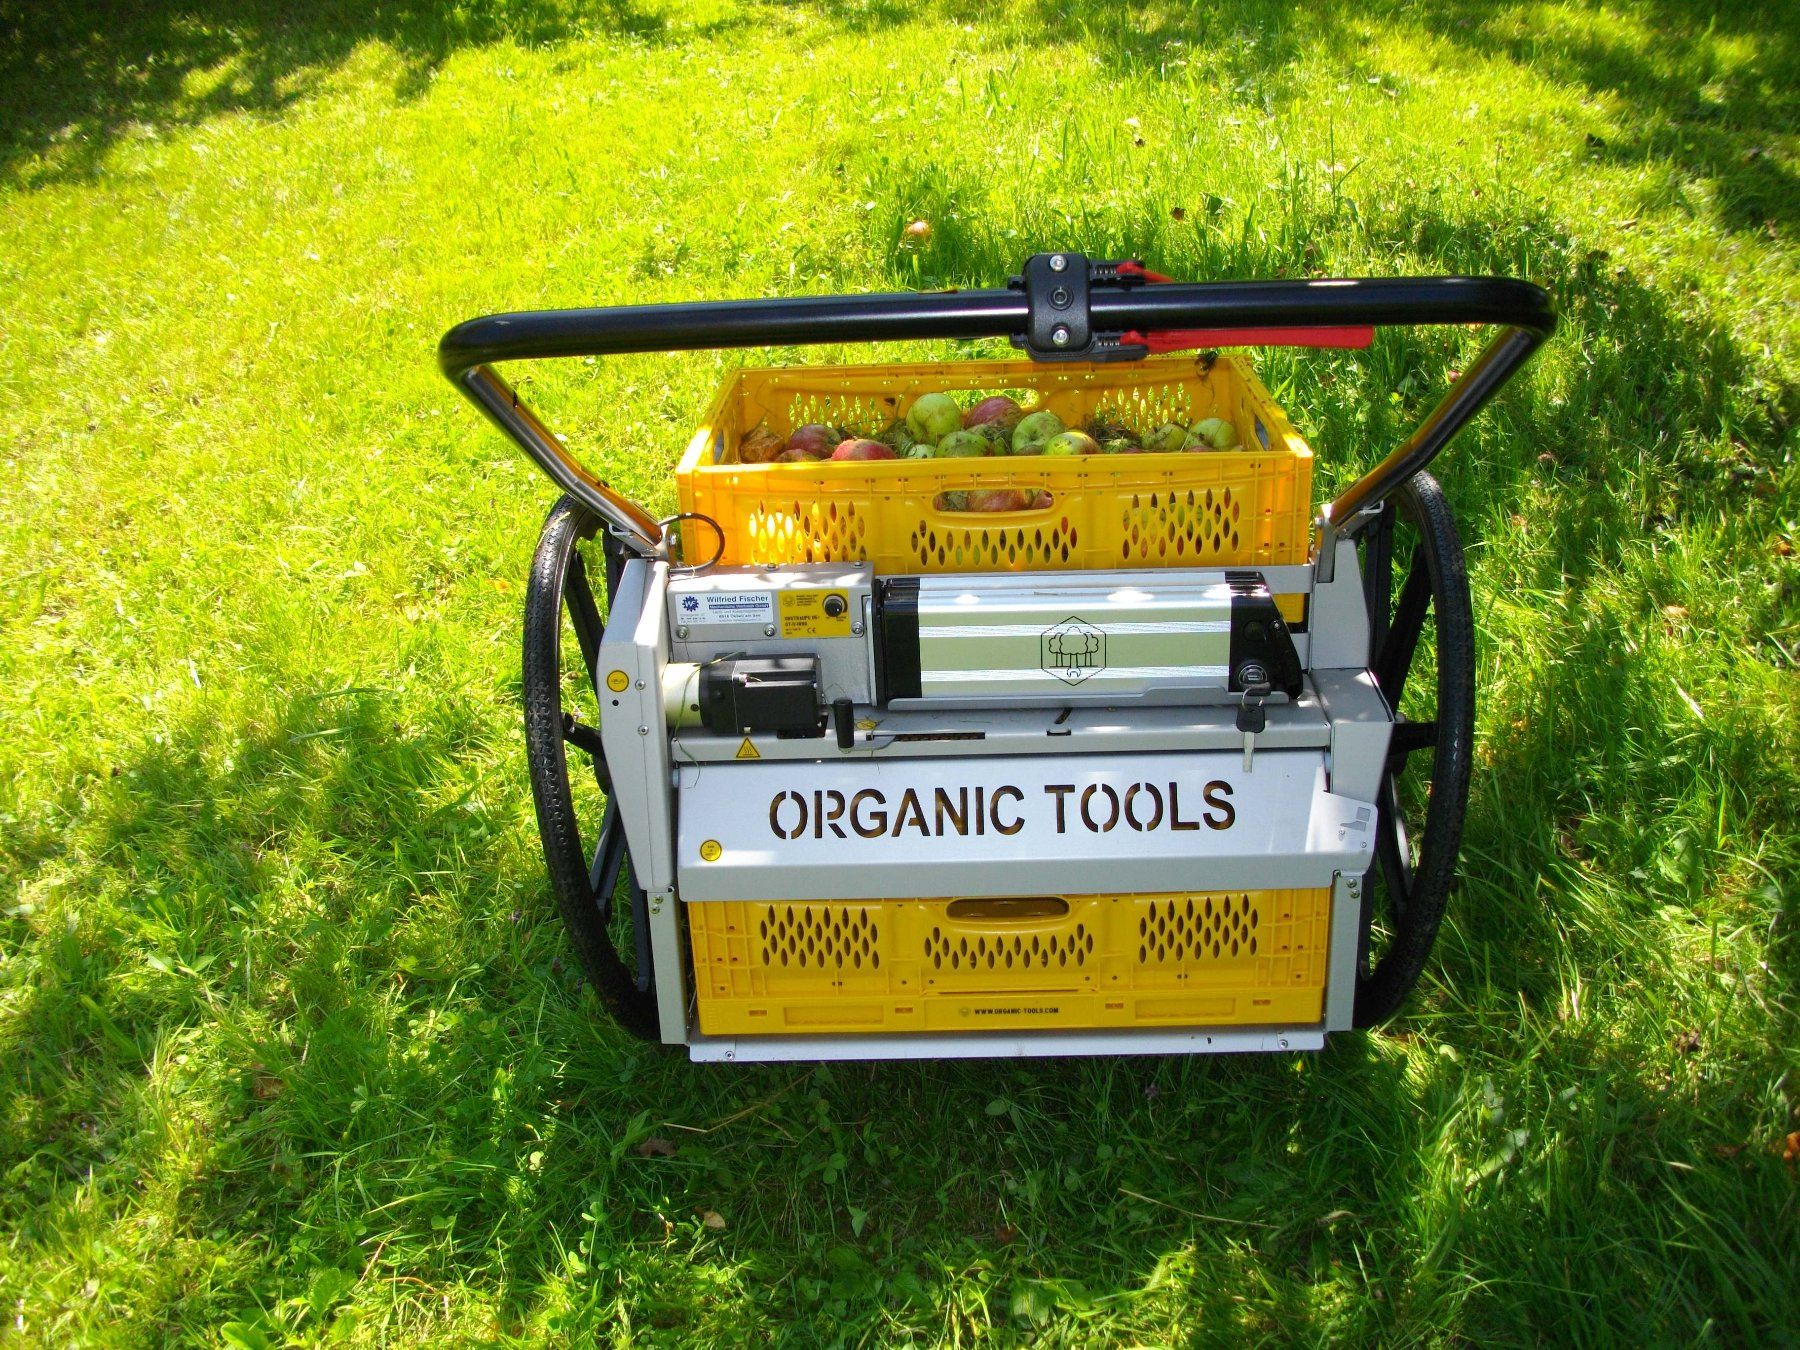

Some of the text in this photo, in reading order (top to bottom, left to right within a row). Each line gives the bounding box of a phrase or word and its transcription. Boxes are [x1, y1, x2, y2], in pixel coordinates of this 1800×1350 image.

[769, 780, 1236, 840] ORGANIC TOOLS
[974, 1007, 1059, 1015] WWW.ORGANIC-TOOLS.COM
